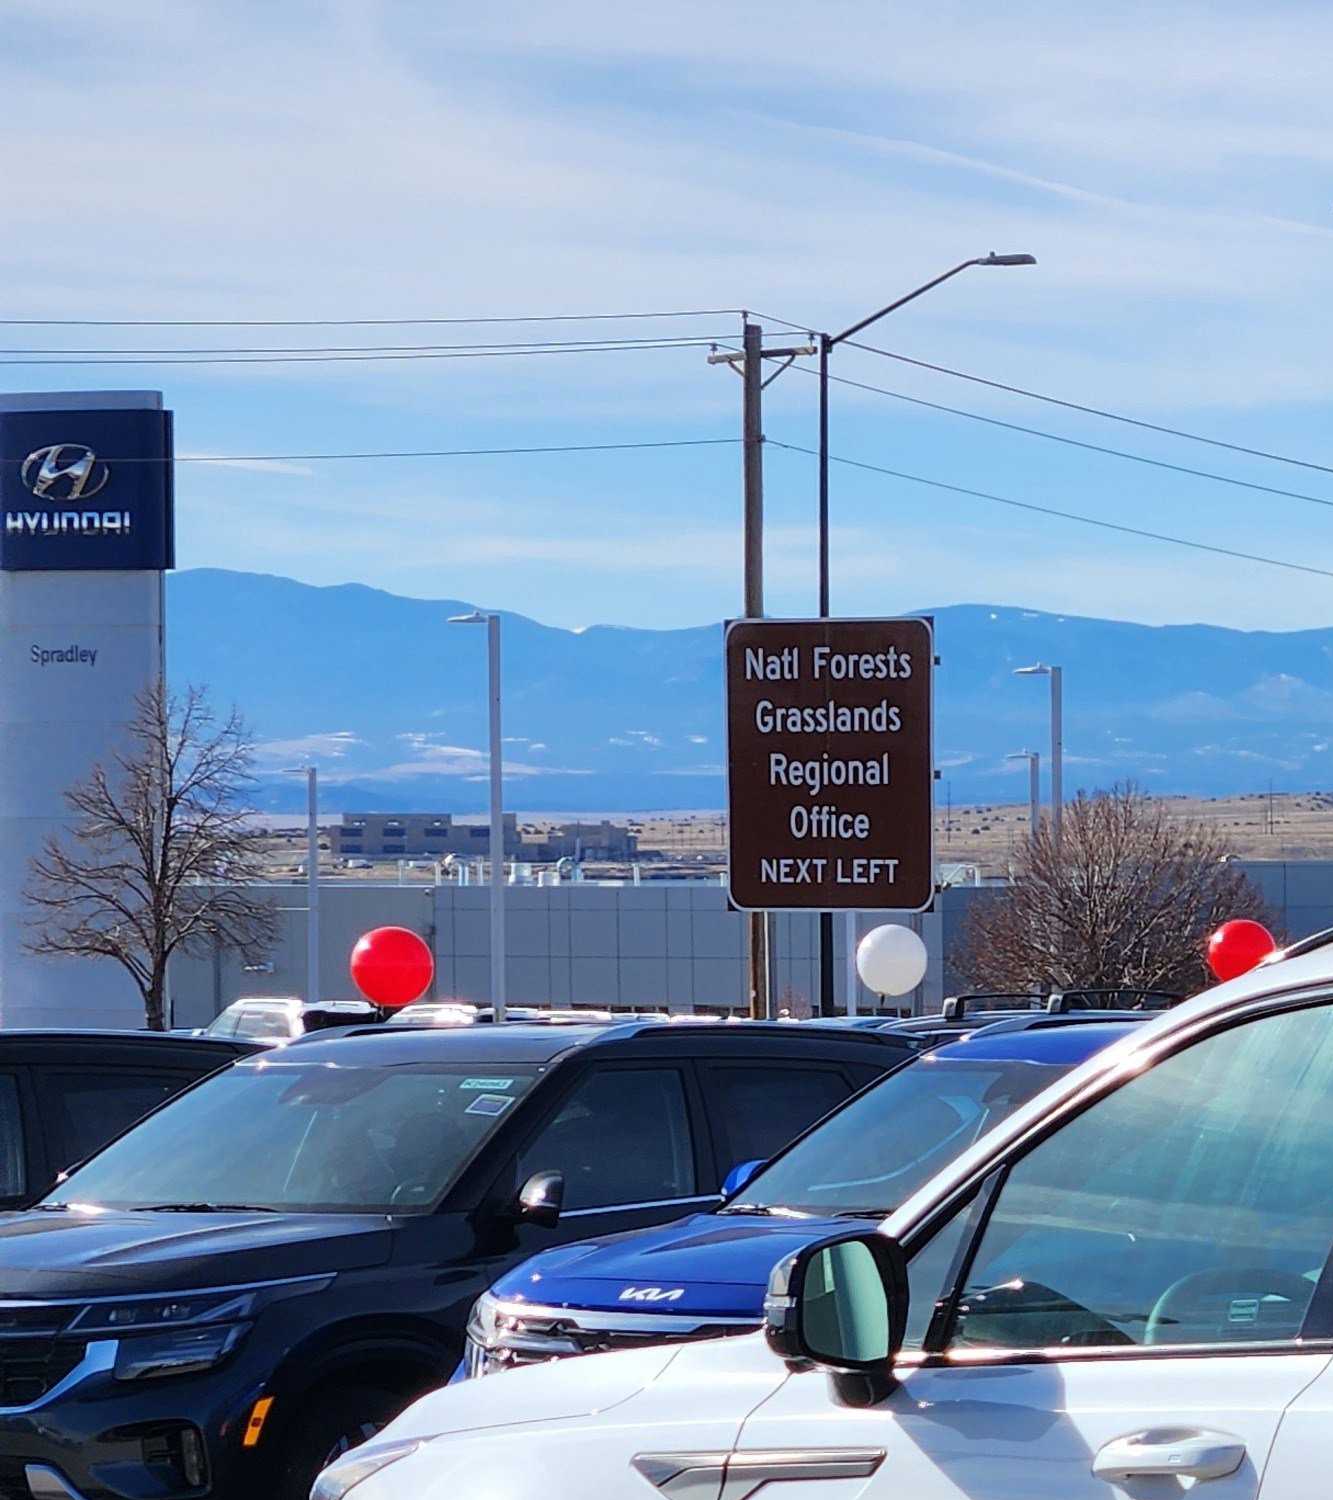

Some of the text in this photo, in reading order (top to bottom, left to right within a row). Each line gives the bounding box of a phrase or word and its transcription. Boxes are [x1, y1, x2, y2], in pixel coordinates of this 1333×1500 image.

[6, 511, 130, 535] HYUNDAI
[30, 645, 97, 666] Spradley
[745, 646, 912, 680] Natl Forests
[755, 699, 901, 733] Grasslands
[770, 753, 889, 796] Regional
[790, 805, 870, 839] Office
[760, 858, 899, 884] NEXT LEFT
